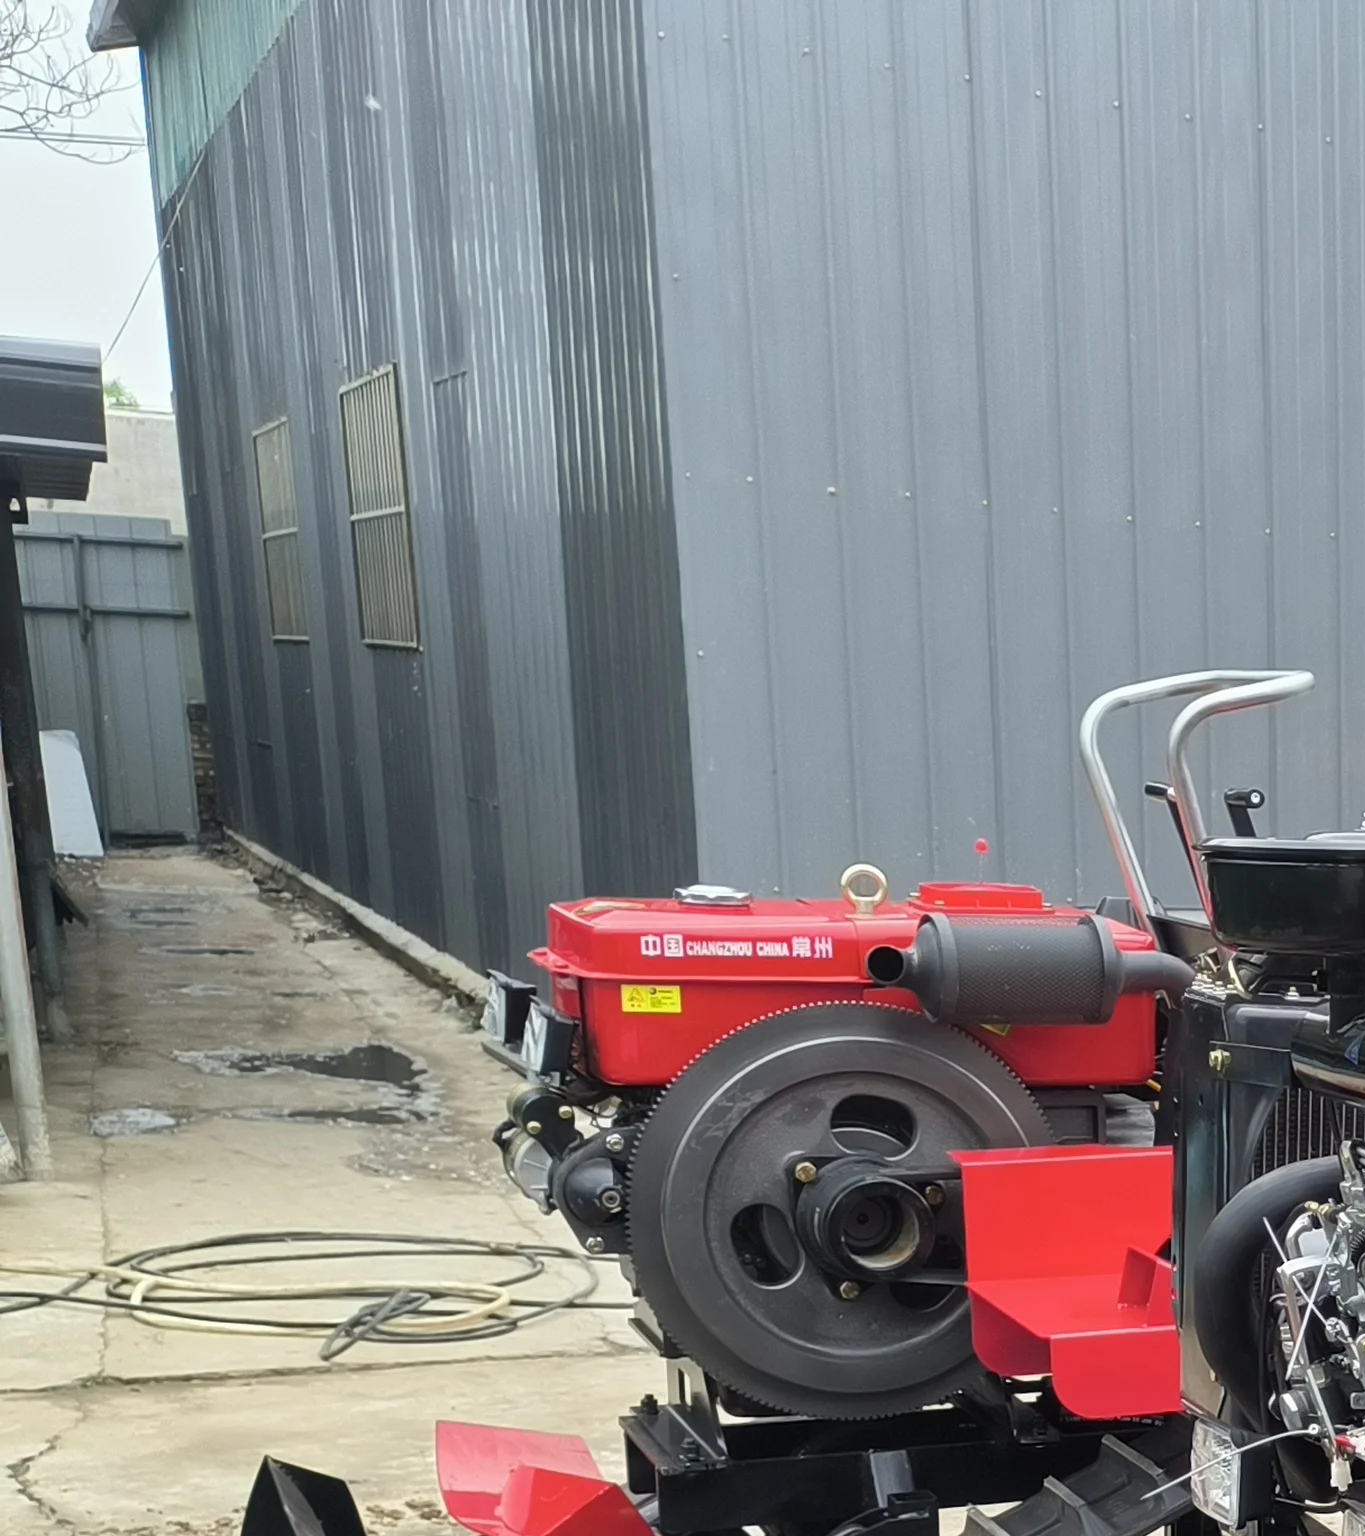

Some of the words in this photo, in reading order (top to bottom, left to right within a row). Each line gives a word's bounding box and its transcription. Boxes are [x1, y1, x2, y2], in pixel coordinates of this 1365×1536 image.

[640, 934, 684, 957] 中国
[686, 940, 753, 957] CHANGZHOU
[756, 942, 789, 957] CHINA
[791, 936, 833, 958] 常州
